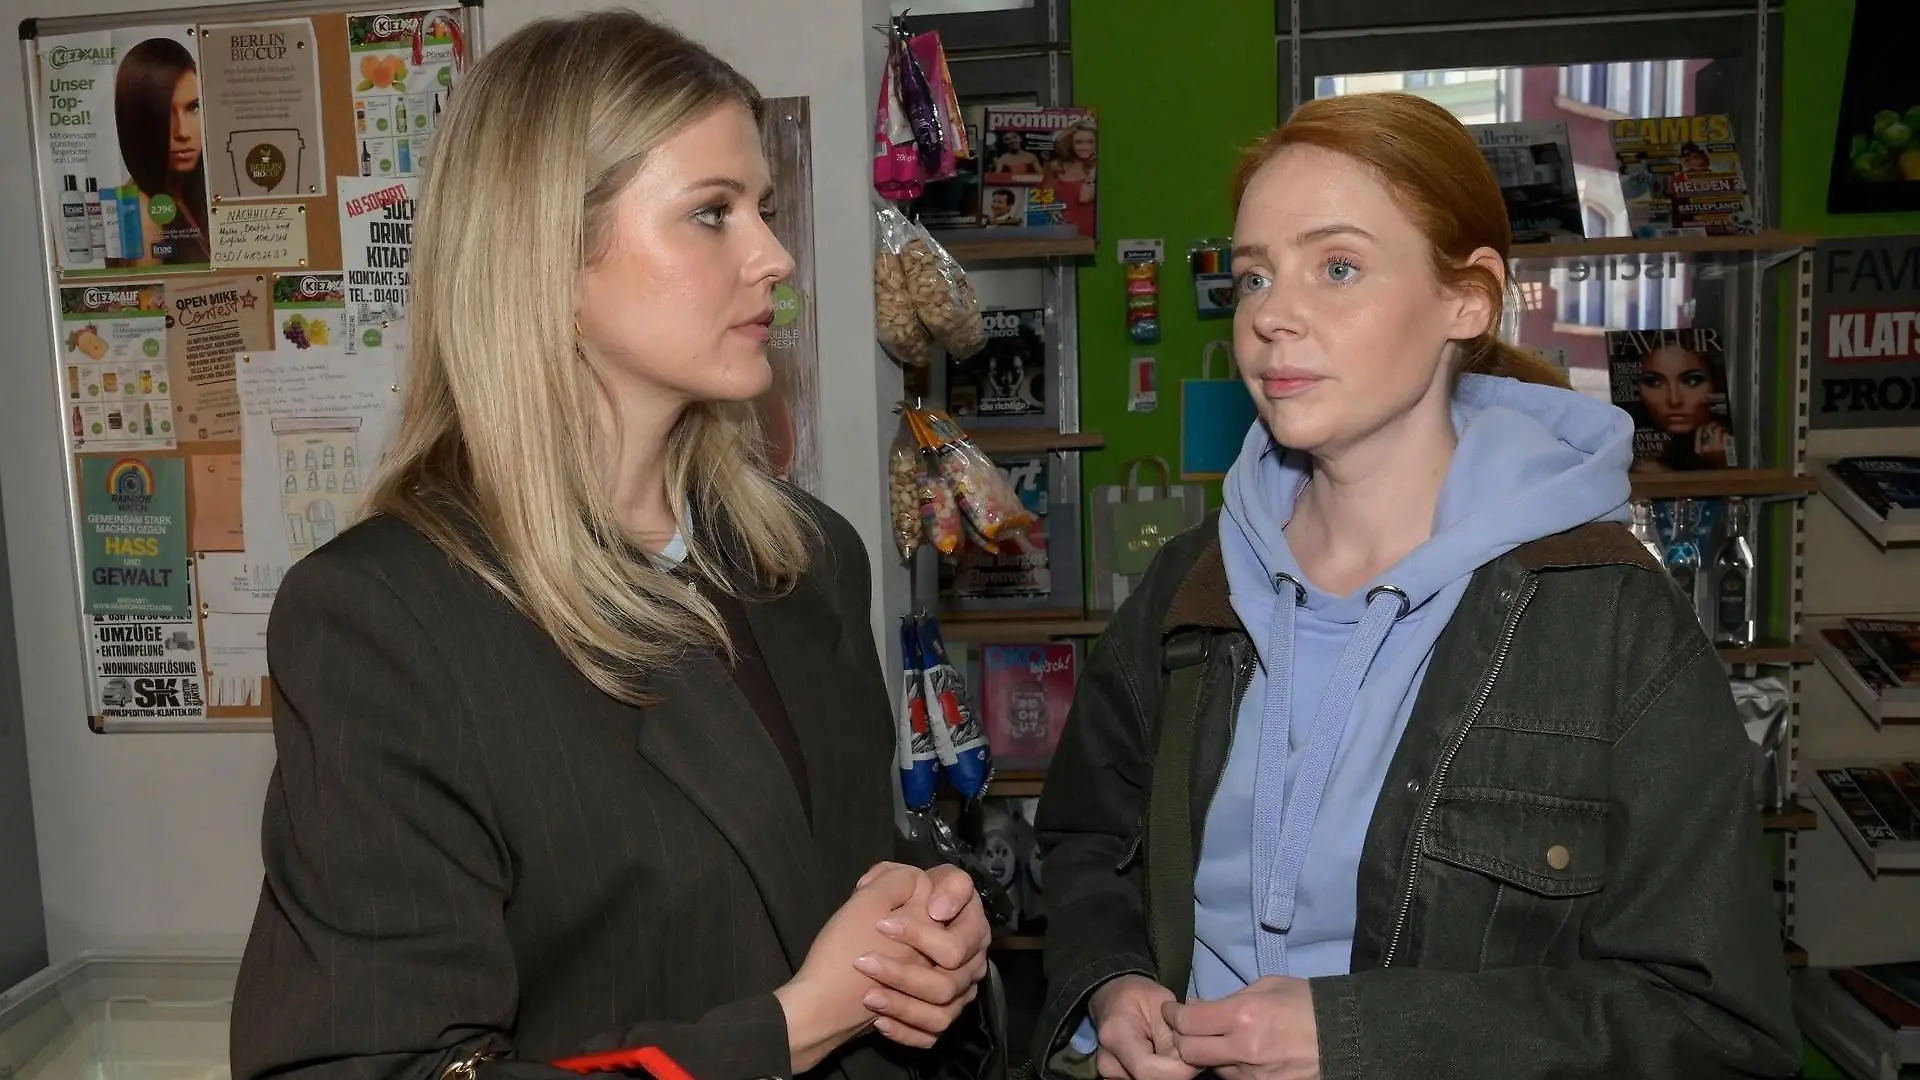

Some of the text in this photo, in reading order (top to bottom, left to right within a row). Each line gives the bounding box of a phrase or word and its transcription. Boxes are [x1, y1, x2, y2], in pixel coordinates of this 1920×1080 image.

[230, 33, 285, 48] BERLIN
[231, 47, 287, 61] BIOCUP
[50, 78, 95, 92] Unser
[49, 94, 83, 112] Top-
[49, 110, 91, 126] Deal!
[1674, 179, 1730, 193] HELDEN
[1031, 187, 1056, 204] 23
[227, 207, 289, 221] NACHHILFE
[345, 200, 362, 218] AB
[349, 270, 398, 287] KONTAKT:
[176, 289, 240, 311] OPEN MIKE
[981, 311, 1020, 328] oto
[769, 328, 800, 340] OUBLE
[87, 514, 172, 525] GEMEINSAM STARK
[95, 524, 166, 535] MACHEN GEGEN
[105, 536, 159, 556] HASS
[123, 558, 141, 566] UND
[92, 566, 173, 588] GEWALT
[100, 624, 162, 642] UMZÜGE
[100, 643, 164, 657] ENTRÜMPELUNG
[102, 660, 197, 675] WOHNUNGSAUFLÖSUNG
[134, 678, 181, 708] SK
